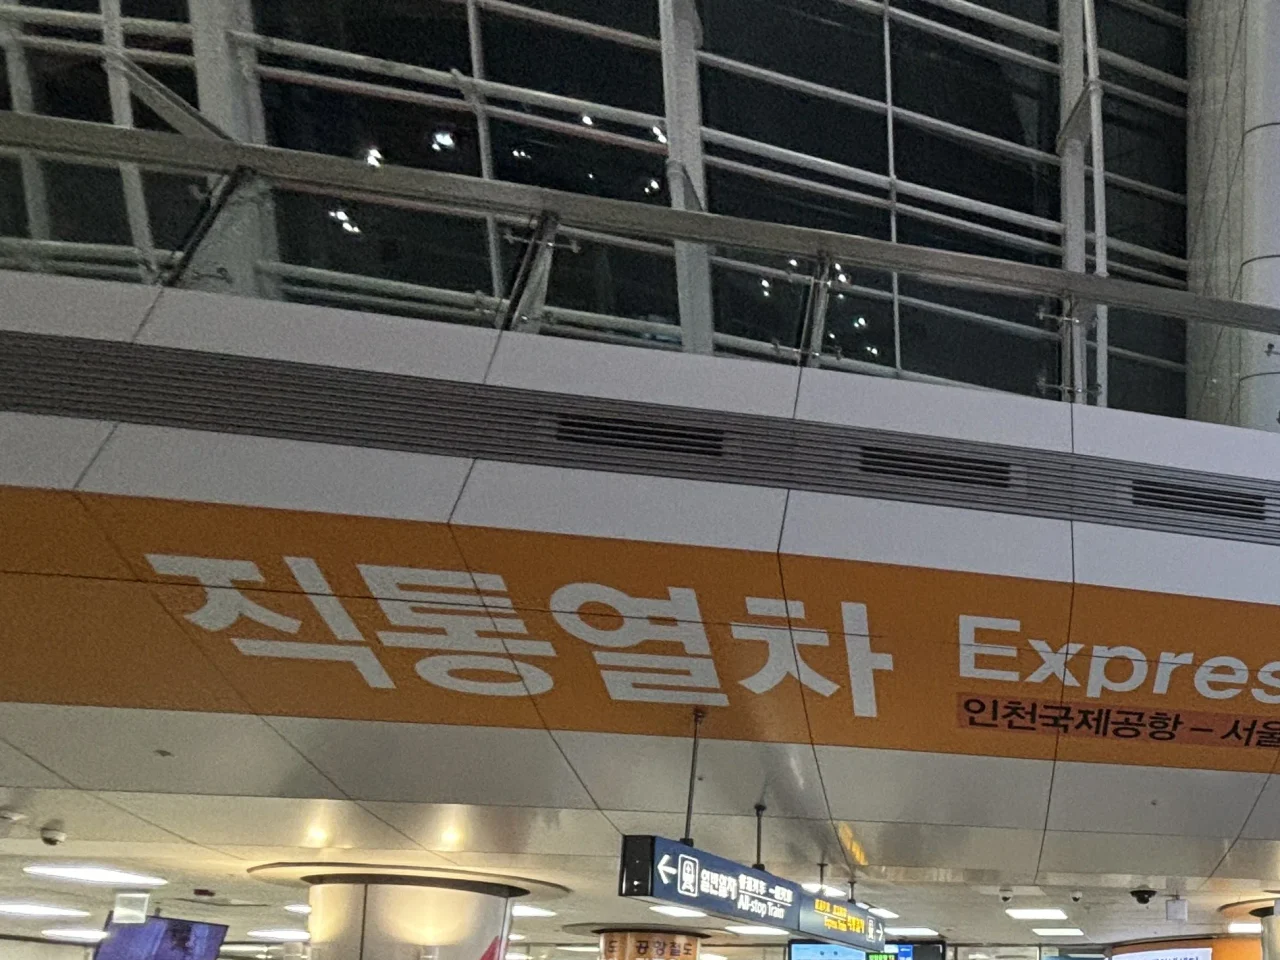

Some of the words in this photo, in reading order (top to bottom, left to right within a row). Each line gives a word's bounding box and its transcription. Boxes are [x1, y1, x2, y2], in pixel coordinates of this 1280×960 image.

[147, 553, 894, 718] 직통열차
[963, 697, 1184, 741] 인천국제공항
[737, 894, 767, 918] All-stop
[767, 901, 785, 920] Train
[636, 940, 693, 957] 공항철도
